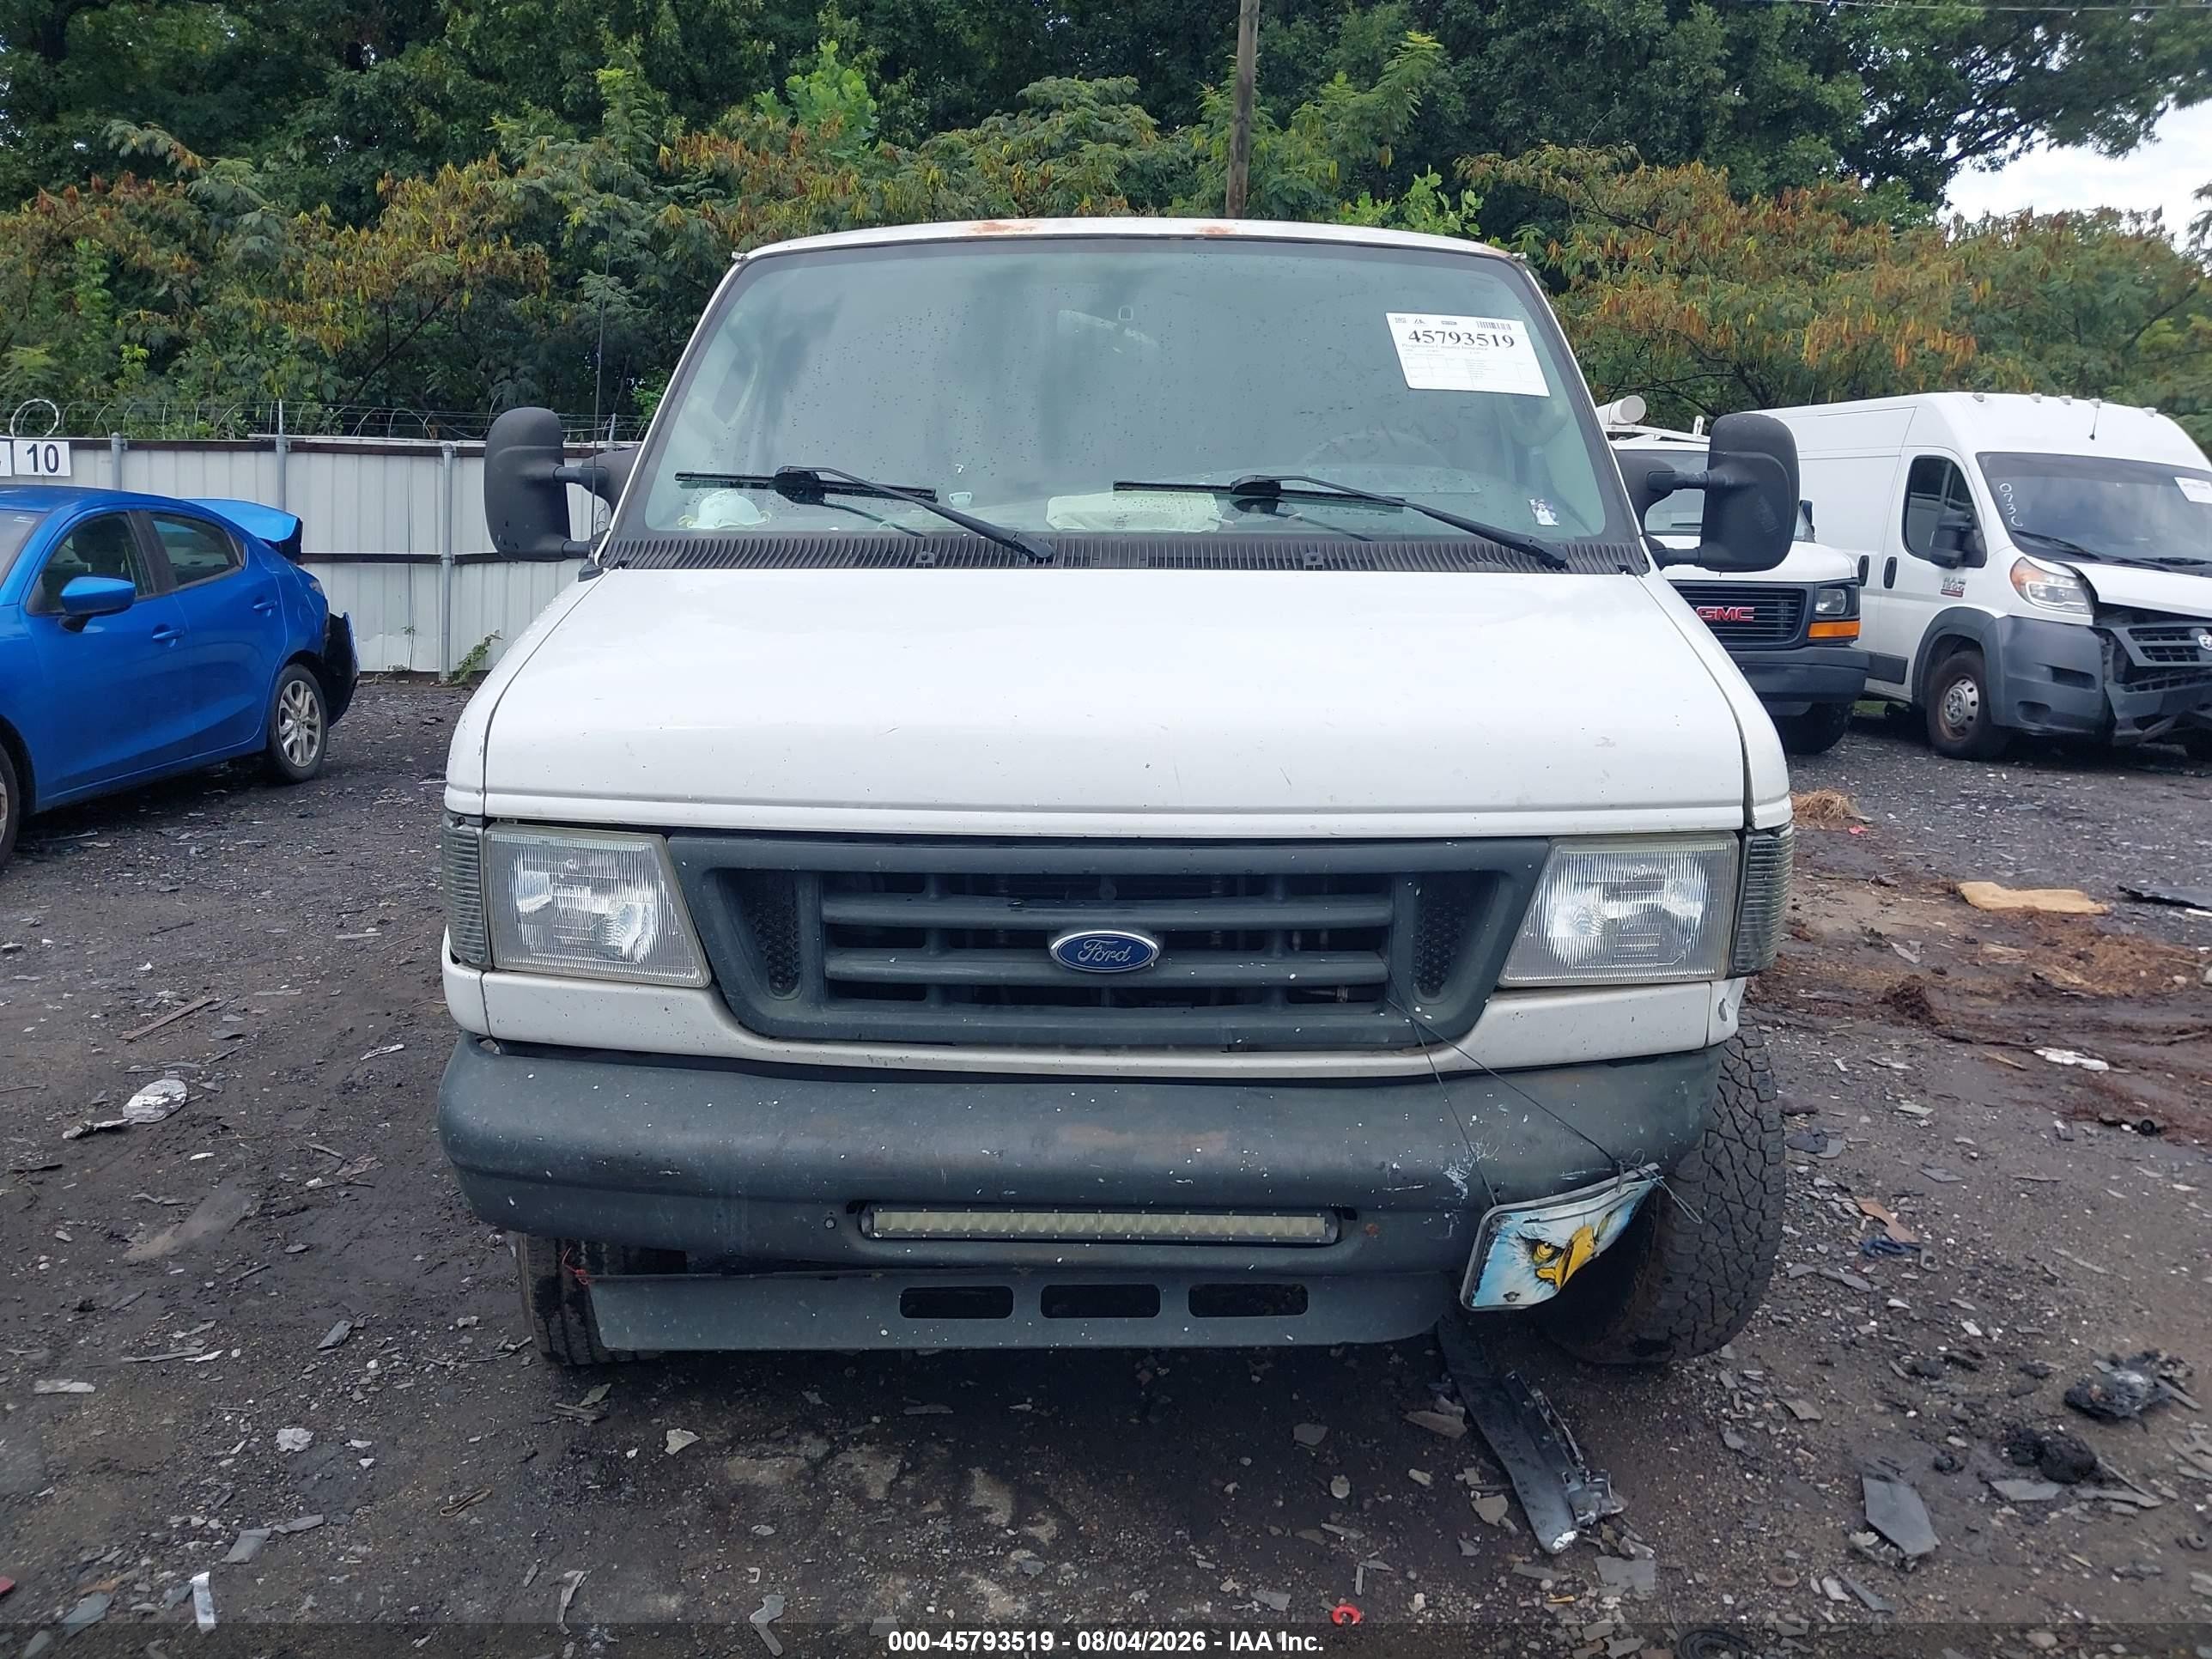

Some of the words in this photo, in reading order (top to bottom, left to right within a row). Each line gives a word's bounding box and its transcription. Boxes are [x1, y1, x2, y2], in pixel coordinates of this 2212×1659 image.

[1408, 330, 1515, 349] 45793519
[27, 443, 59, 473] 10
[1697, 606, 1754, 621] GMC
[1078, 939, 1132, 962] Ford
